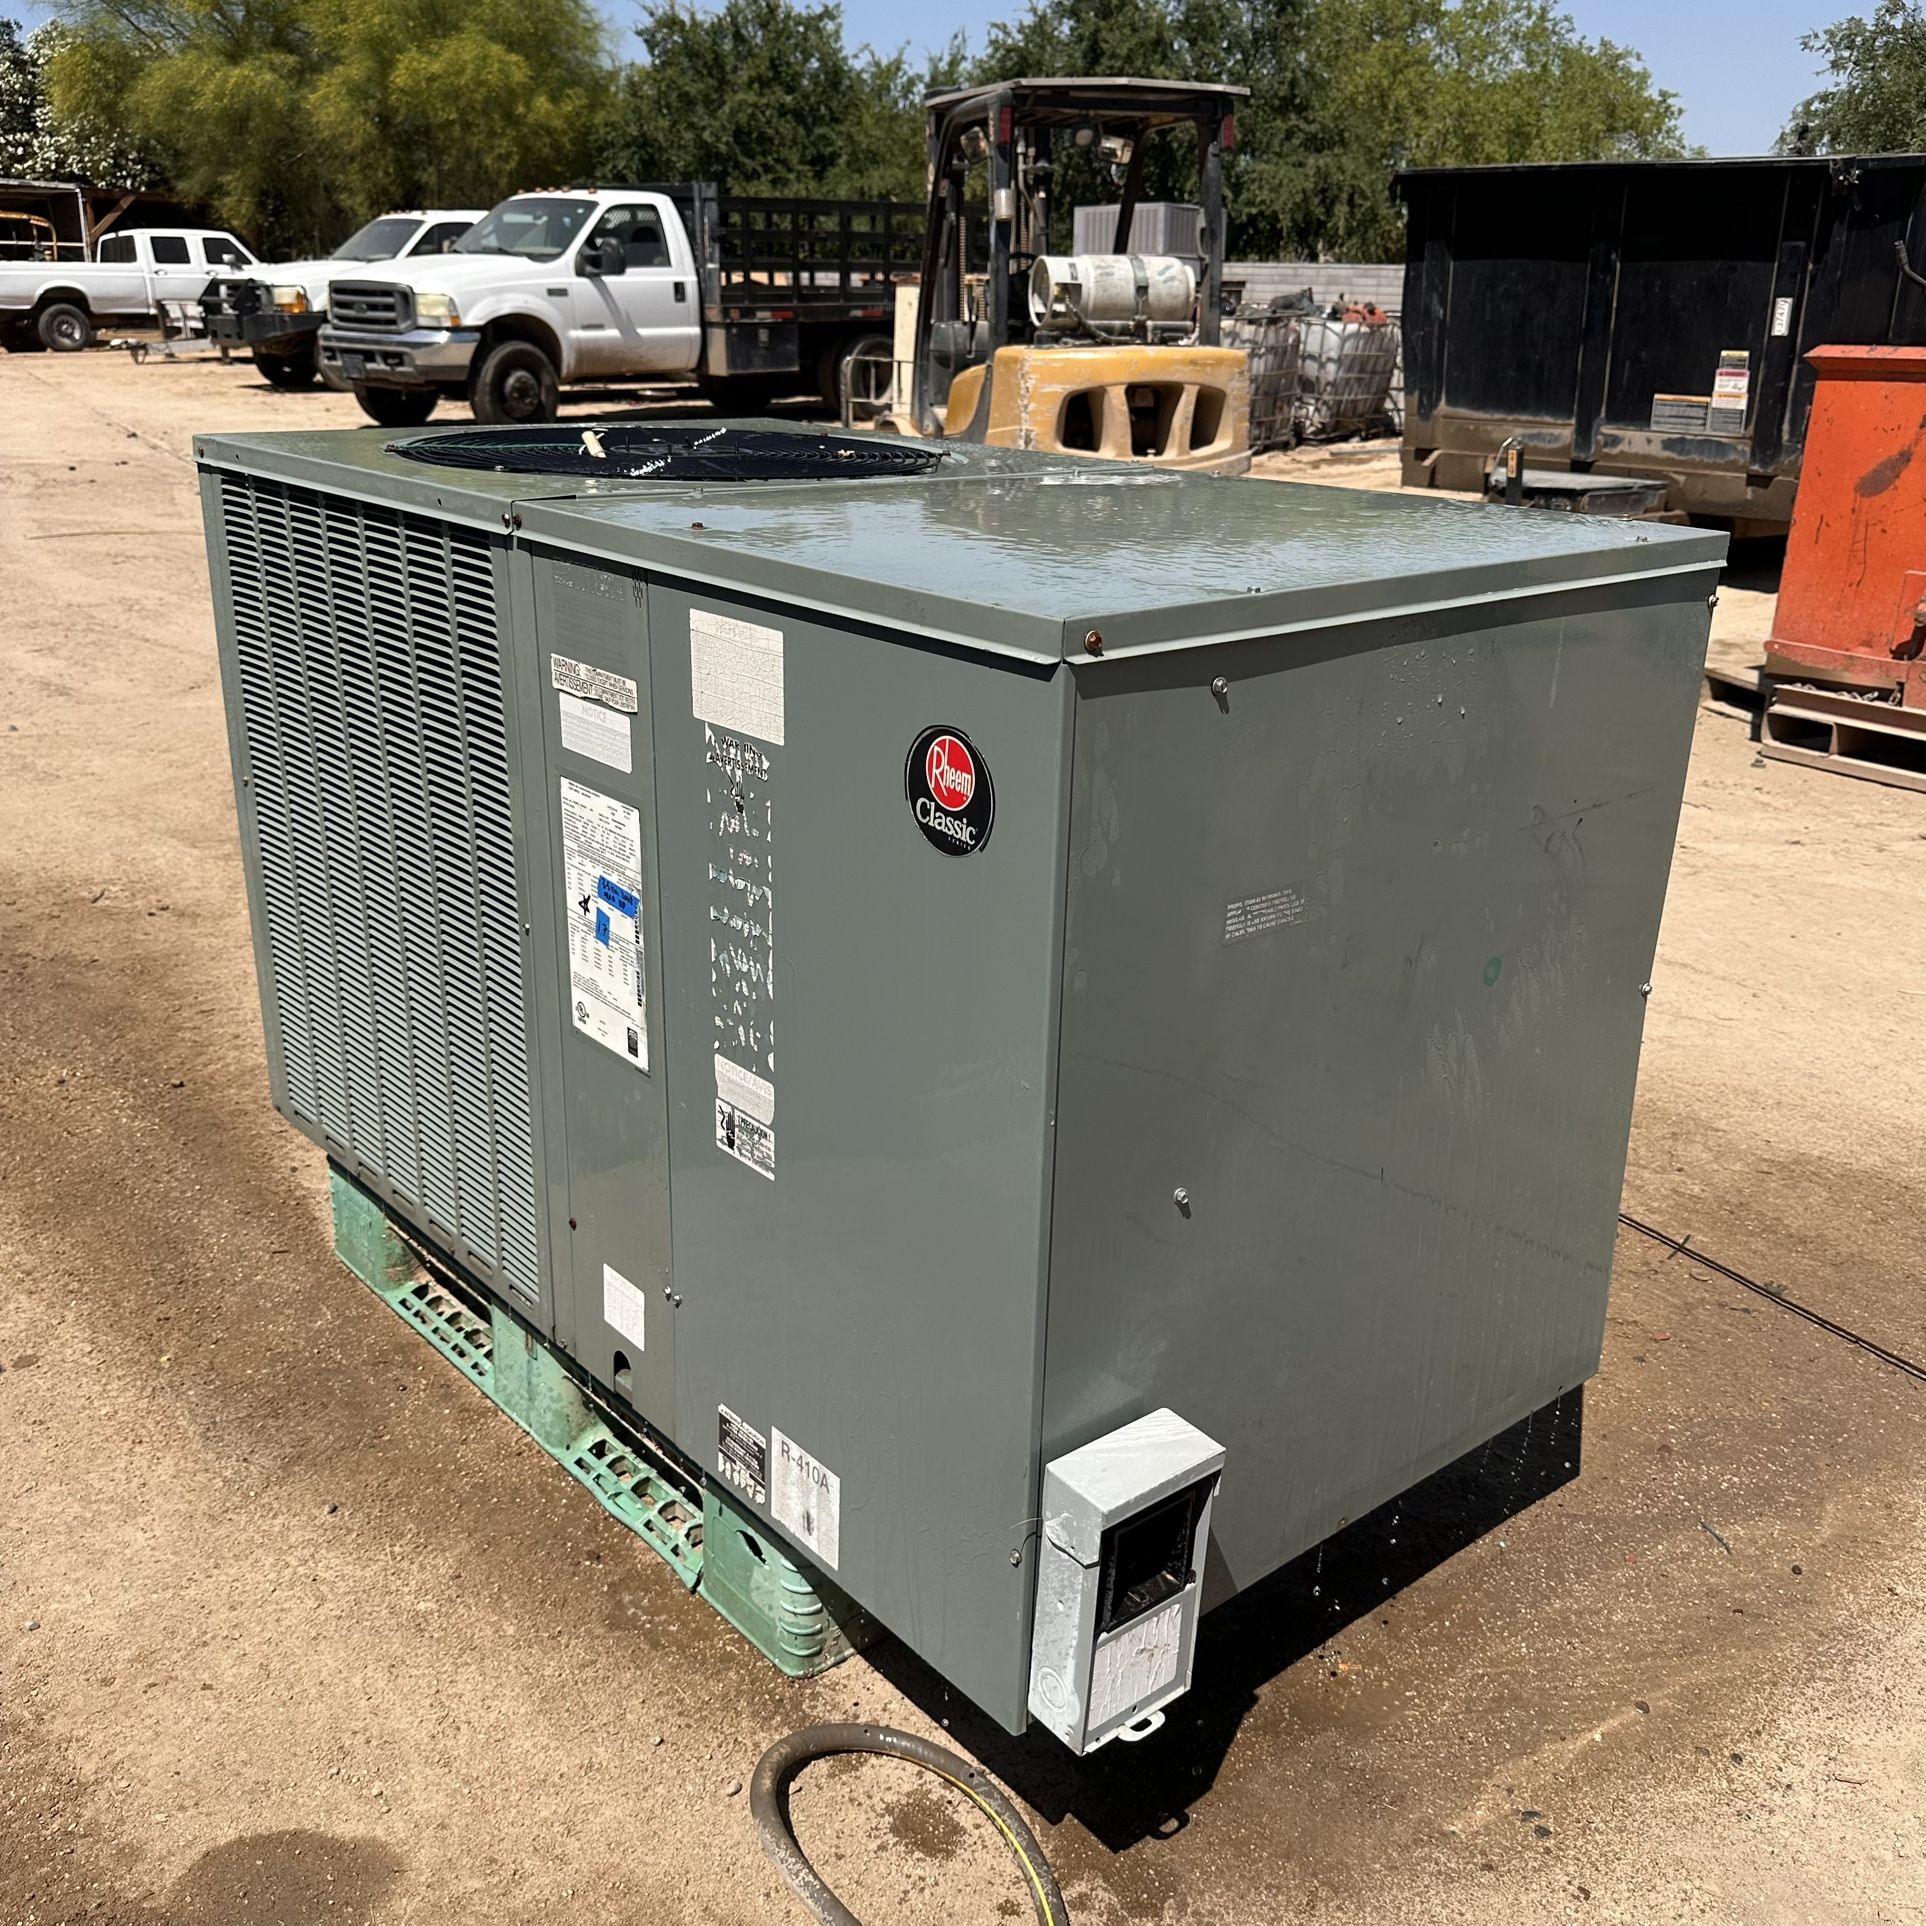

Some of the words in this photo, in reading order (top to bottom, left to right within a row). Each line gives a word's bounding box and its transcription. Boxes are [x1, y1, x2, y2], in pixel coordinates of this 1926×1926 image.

[581, 703, 607, 723] NOTICE
[931, 738, 972, 797] Rheem
[916, 797, 977, 845] Classic
[781, 1440, 830, 1494] R-410A
